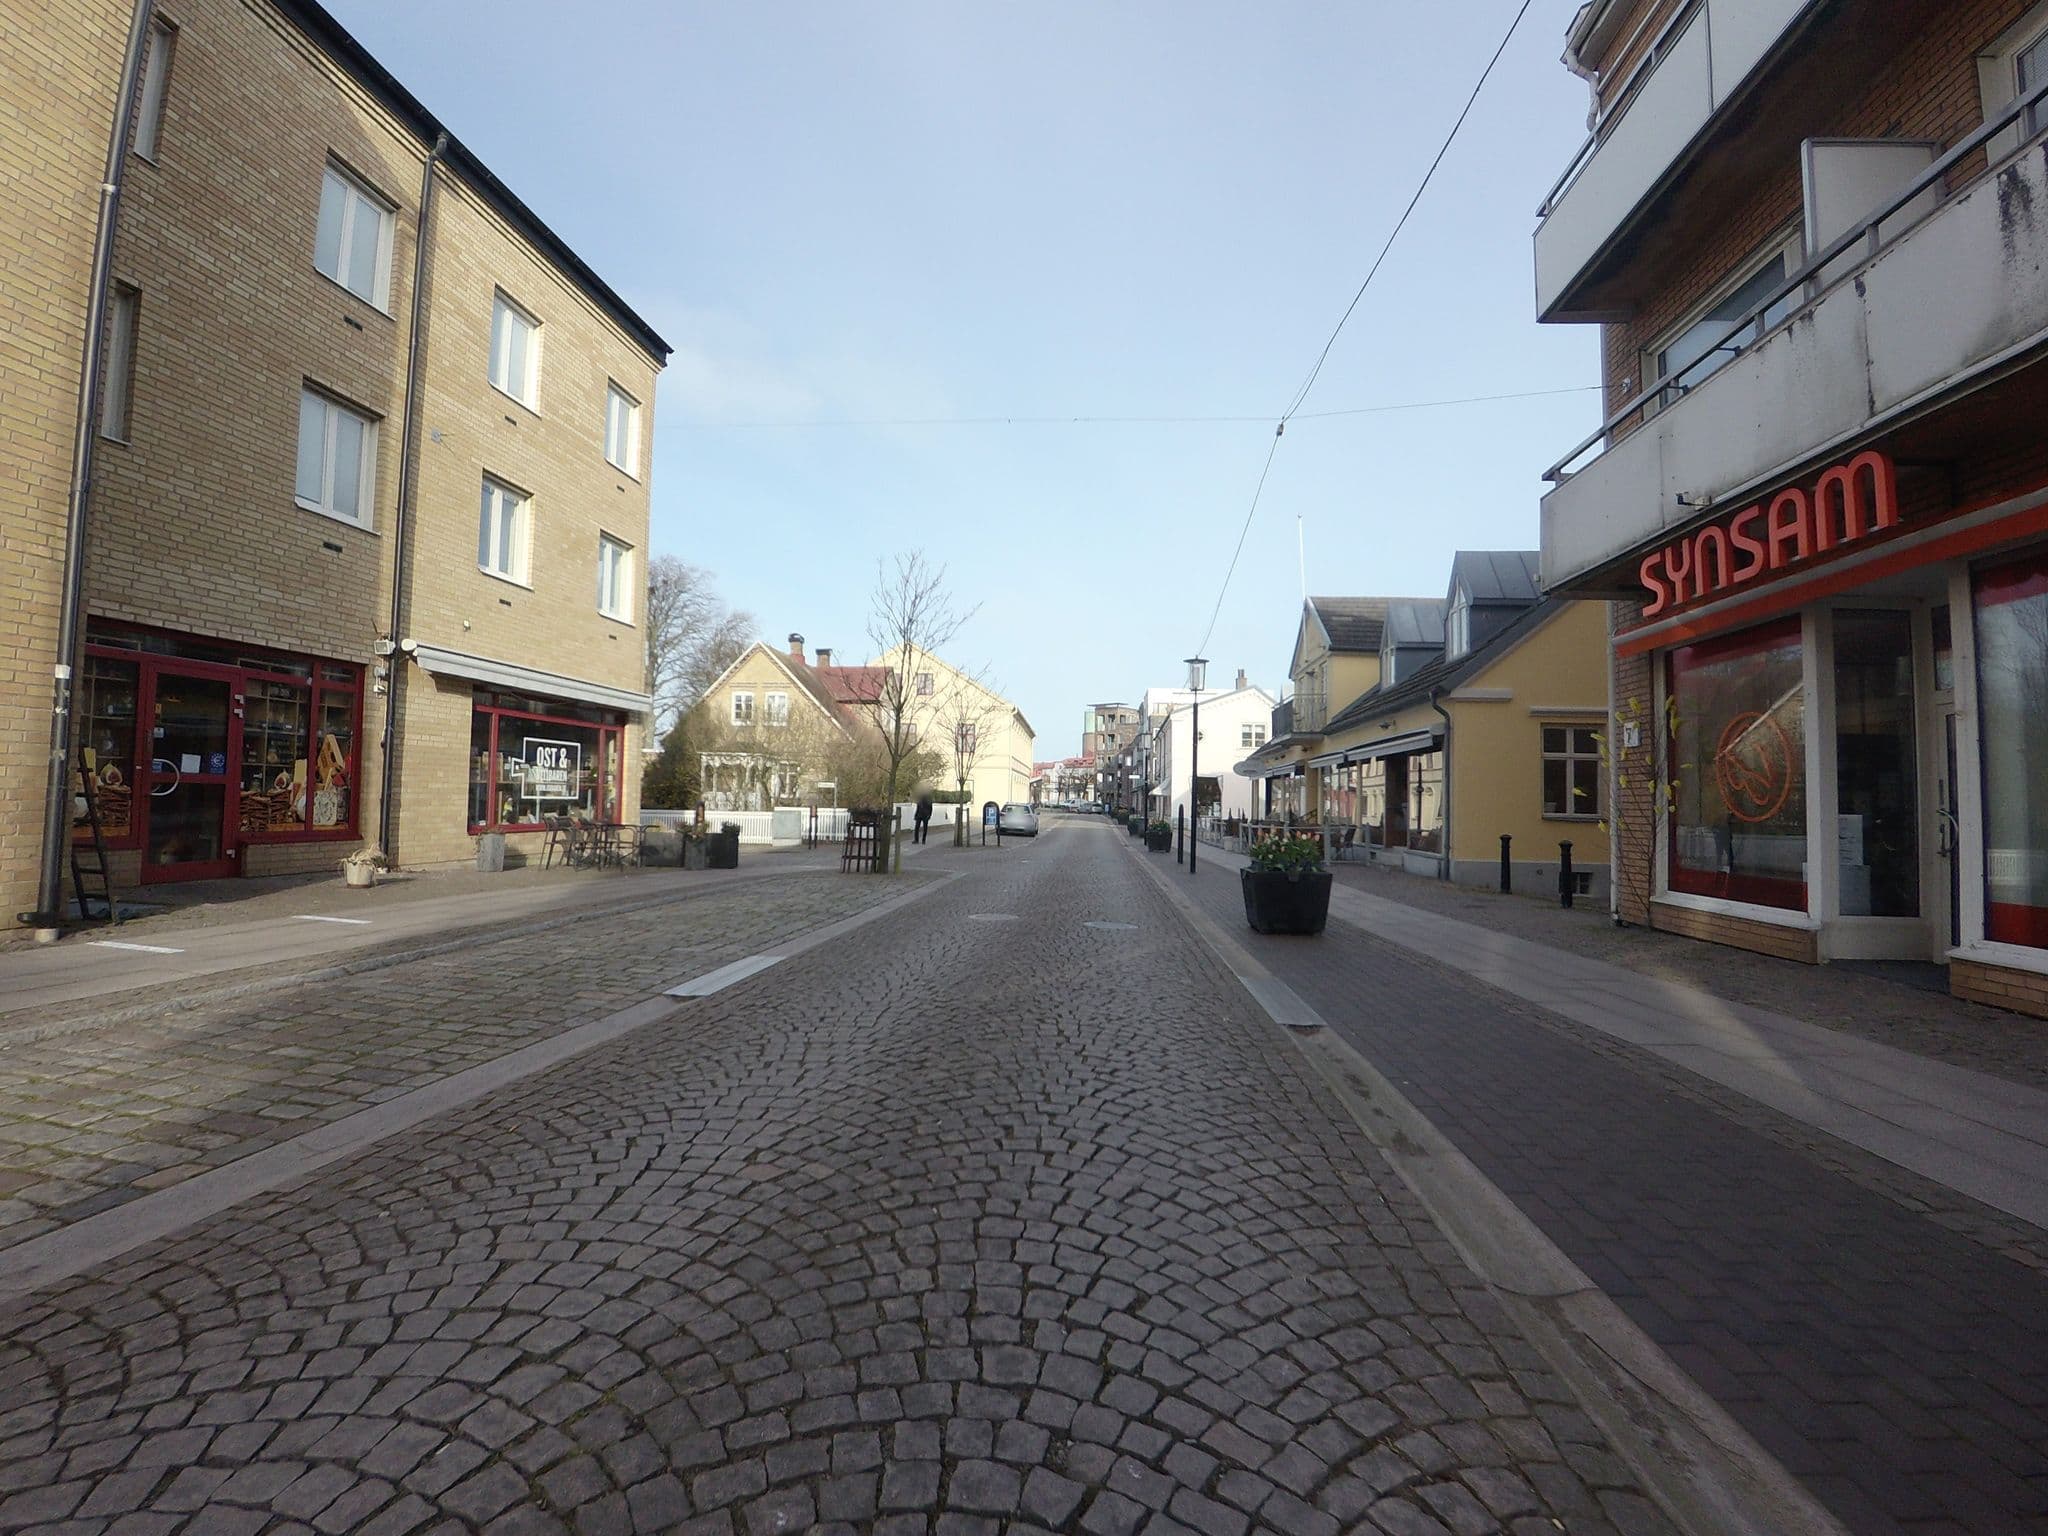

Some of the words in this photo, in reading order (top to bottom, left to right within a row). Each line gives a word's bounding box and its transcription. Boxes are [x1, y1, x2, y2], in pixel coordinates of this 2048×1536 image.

[1640, 451, 1894, 617] SYNSAM
[537, 746, 558, 768] OST
[559, 747, 567, 769] &
